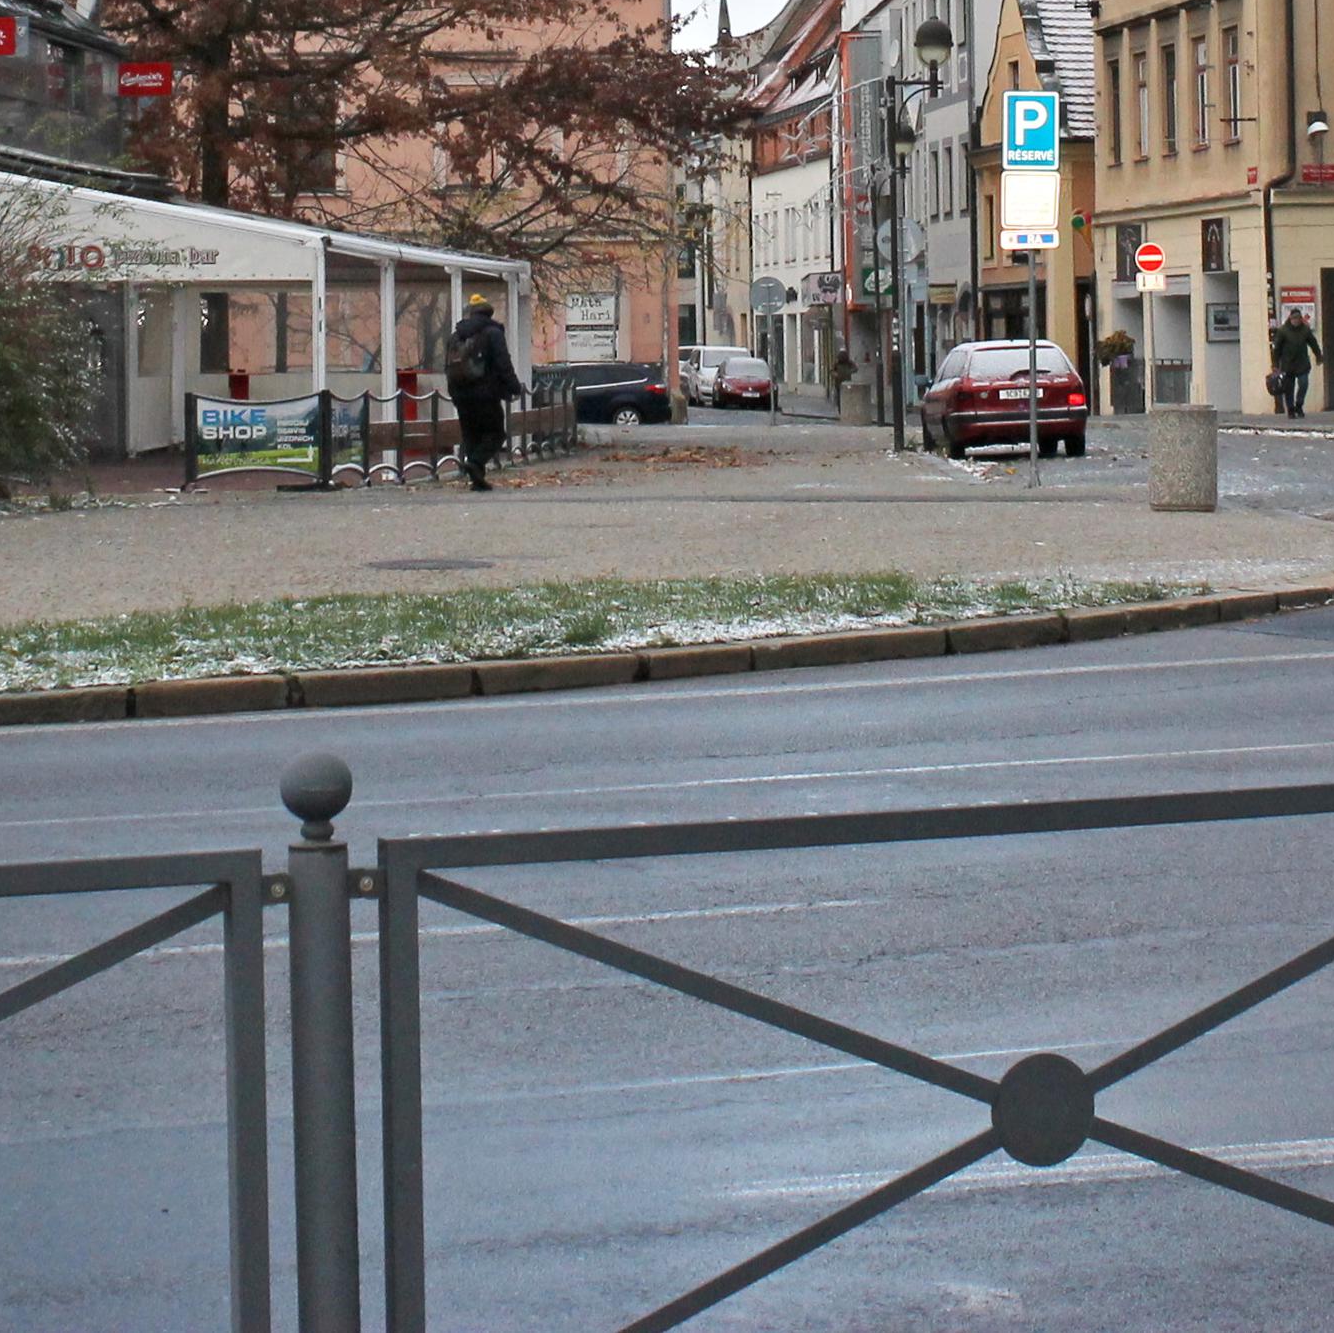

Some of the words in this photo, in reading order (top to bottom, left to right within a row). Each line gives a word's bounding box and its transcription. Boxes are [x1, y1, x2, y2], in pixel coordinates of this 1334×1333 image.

[1015, 100, 1049, 146] P
[190, 247, 219, 265] bar
[203, 409, 267, 426] BIKE
[202, 425, 267, 440] SHOP
